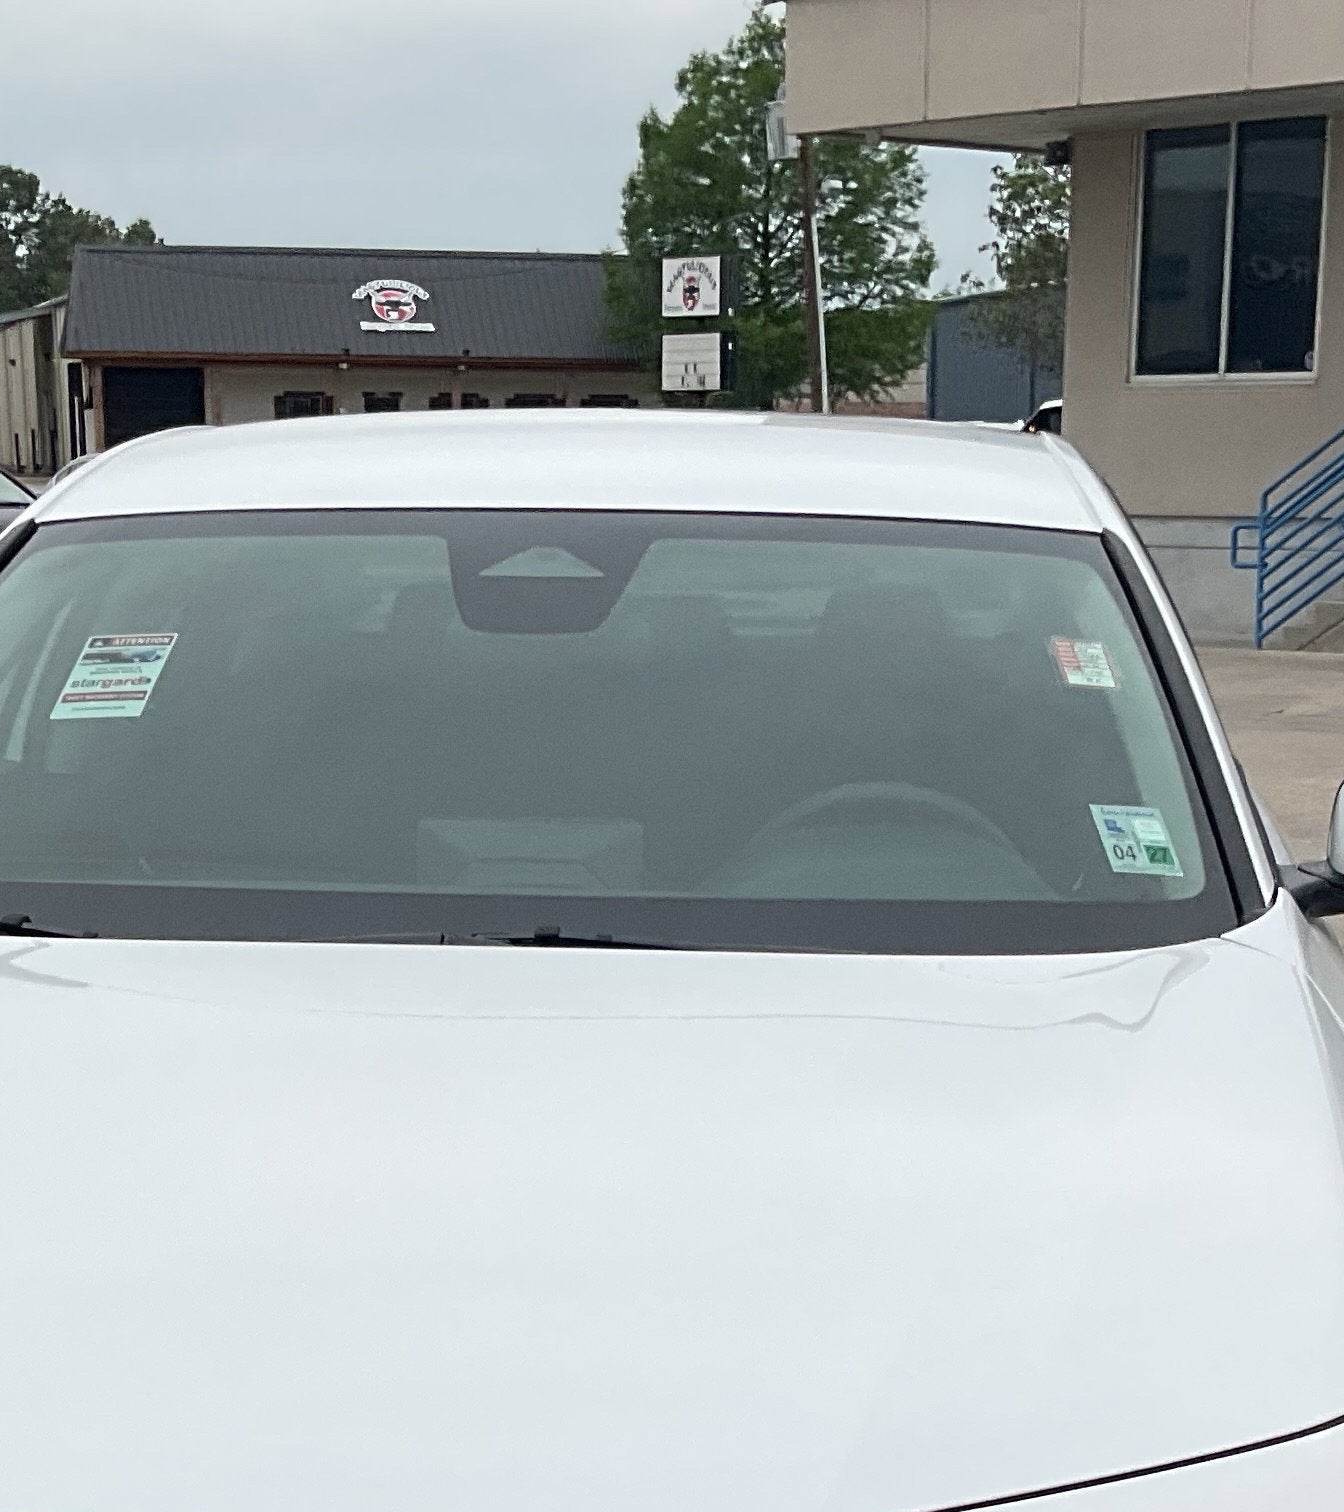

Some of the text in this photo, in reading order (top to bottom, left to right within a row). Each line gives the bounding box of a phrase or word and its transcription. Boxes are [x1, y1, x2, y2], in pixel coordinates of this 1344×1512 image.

[111, 637, 172, 647] ATTENTION
[1113, 844, 1138, 861] 04
[1147, 846, 1168, 863] 27
